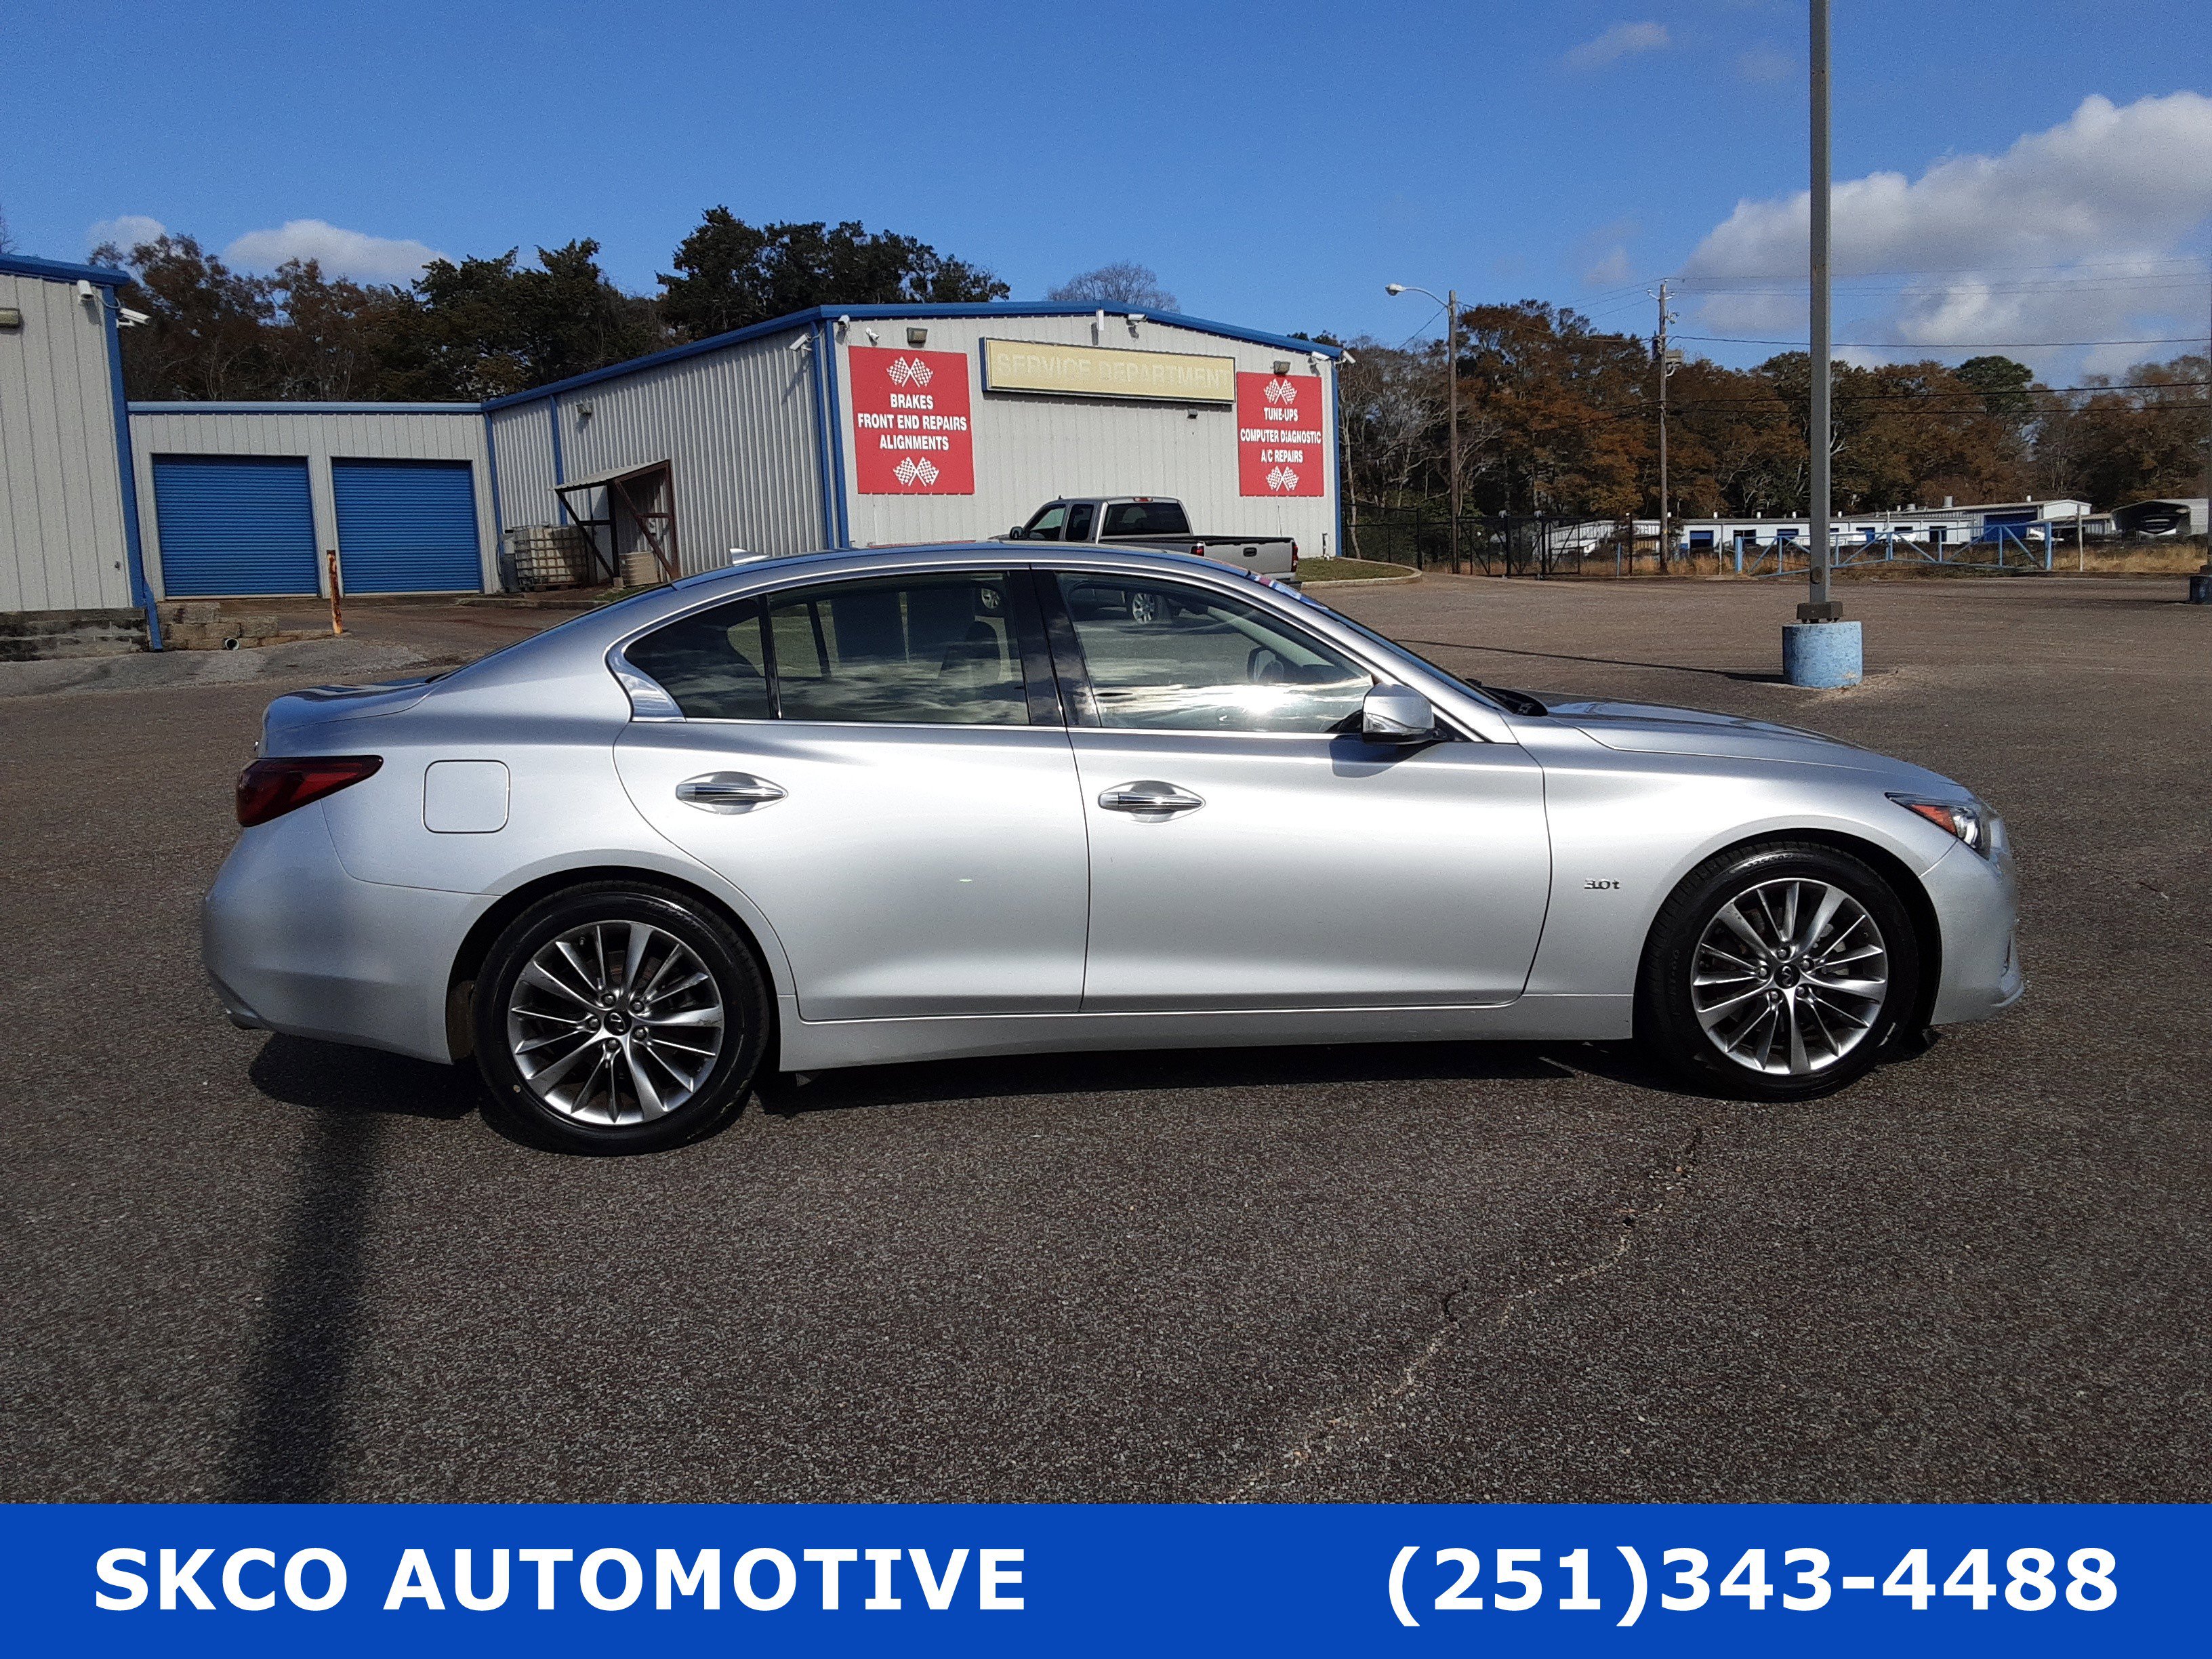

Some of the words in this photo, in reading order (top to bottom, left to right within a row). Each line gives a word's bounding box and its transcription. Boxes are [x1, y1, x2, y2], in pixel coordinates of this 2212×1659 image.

[996, 354, 1090, 378] SERVICE
[1097, 361, 1231, 388] DEPARTMENT
[890, 393, 934, 409] BRAKES
[857, 413, 894, 429] FRONT
[897, 414, 920, 429] END
[922, 415, 968, 431] REPAIRS
[1263, 407, 1298, 422] TUNE-UPS
[879, 434, 949, 451] ALIGNMENTS
[1240, 428, 1279, 443] COMPUTER
[1280, 430, 1321, 444] DIAGNOSTIC
[1261, 449, 1273, 463] A/C
[1274, 449, 1303, 463] REPAIRS
